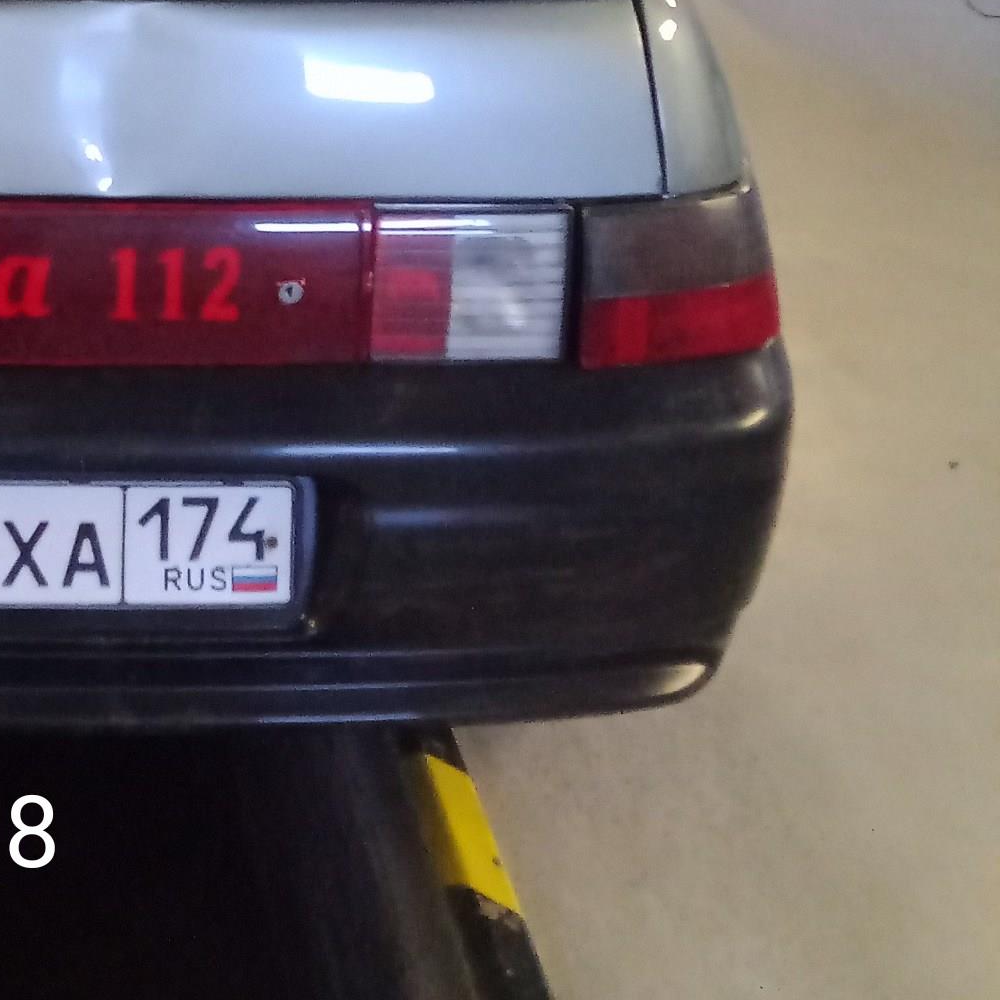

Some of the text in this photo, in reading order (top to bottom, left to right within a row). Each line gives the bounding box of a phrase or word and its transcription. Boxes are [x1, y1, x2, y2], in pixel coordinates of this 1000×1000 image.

[109, 246, 243, 322] 112
[138, 496, 266, 562] 174
[164, 567, 227, 592] RUS
